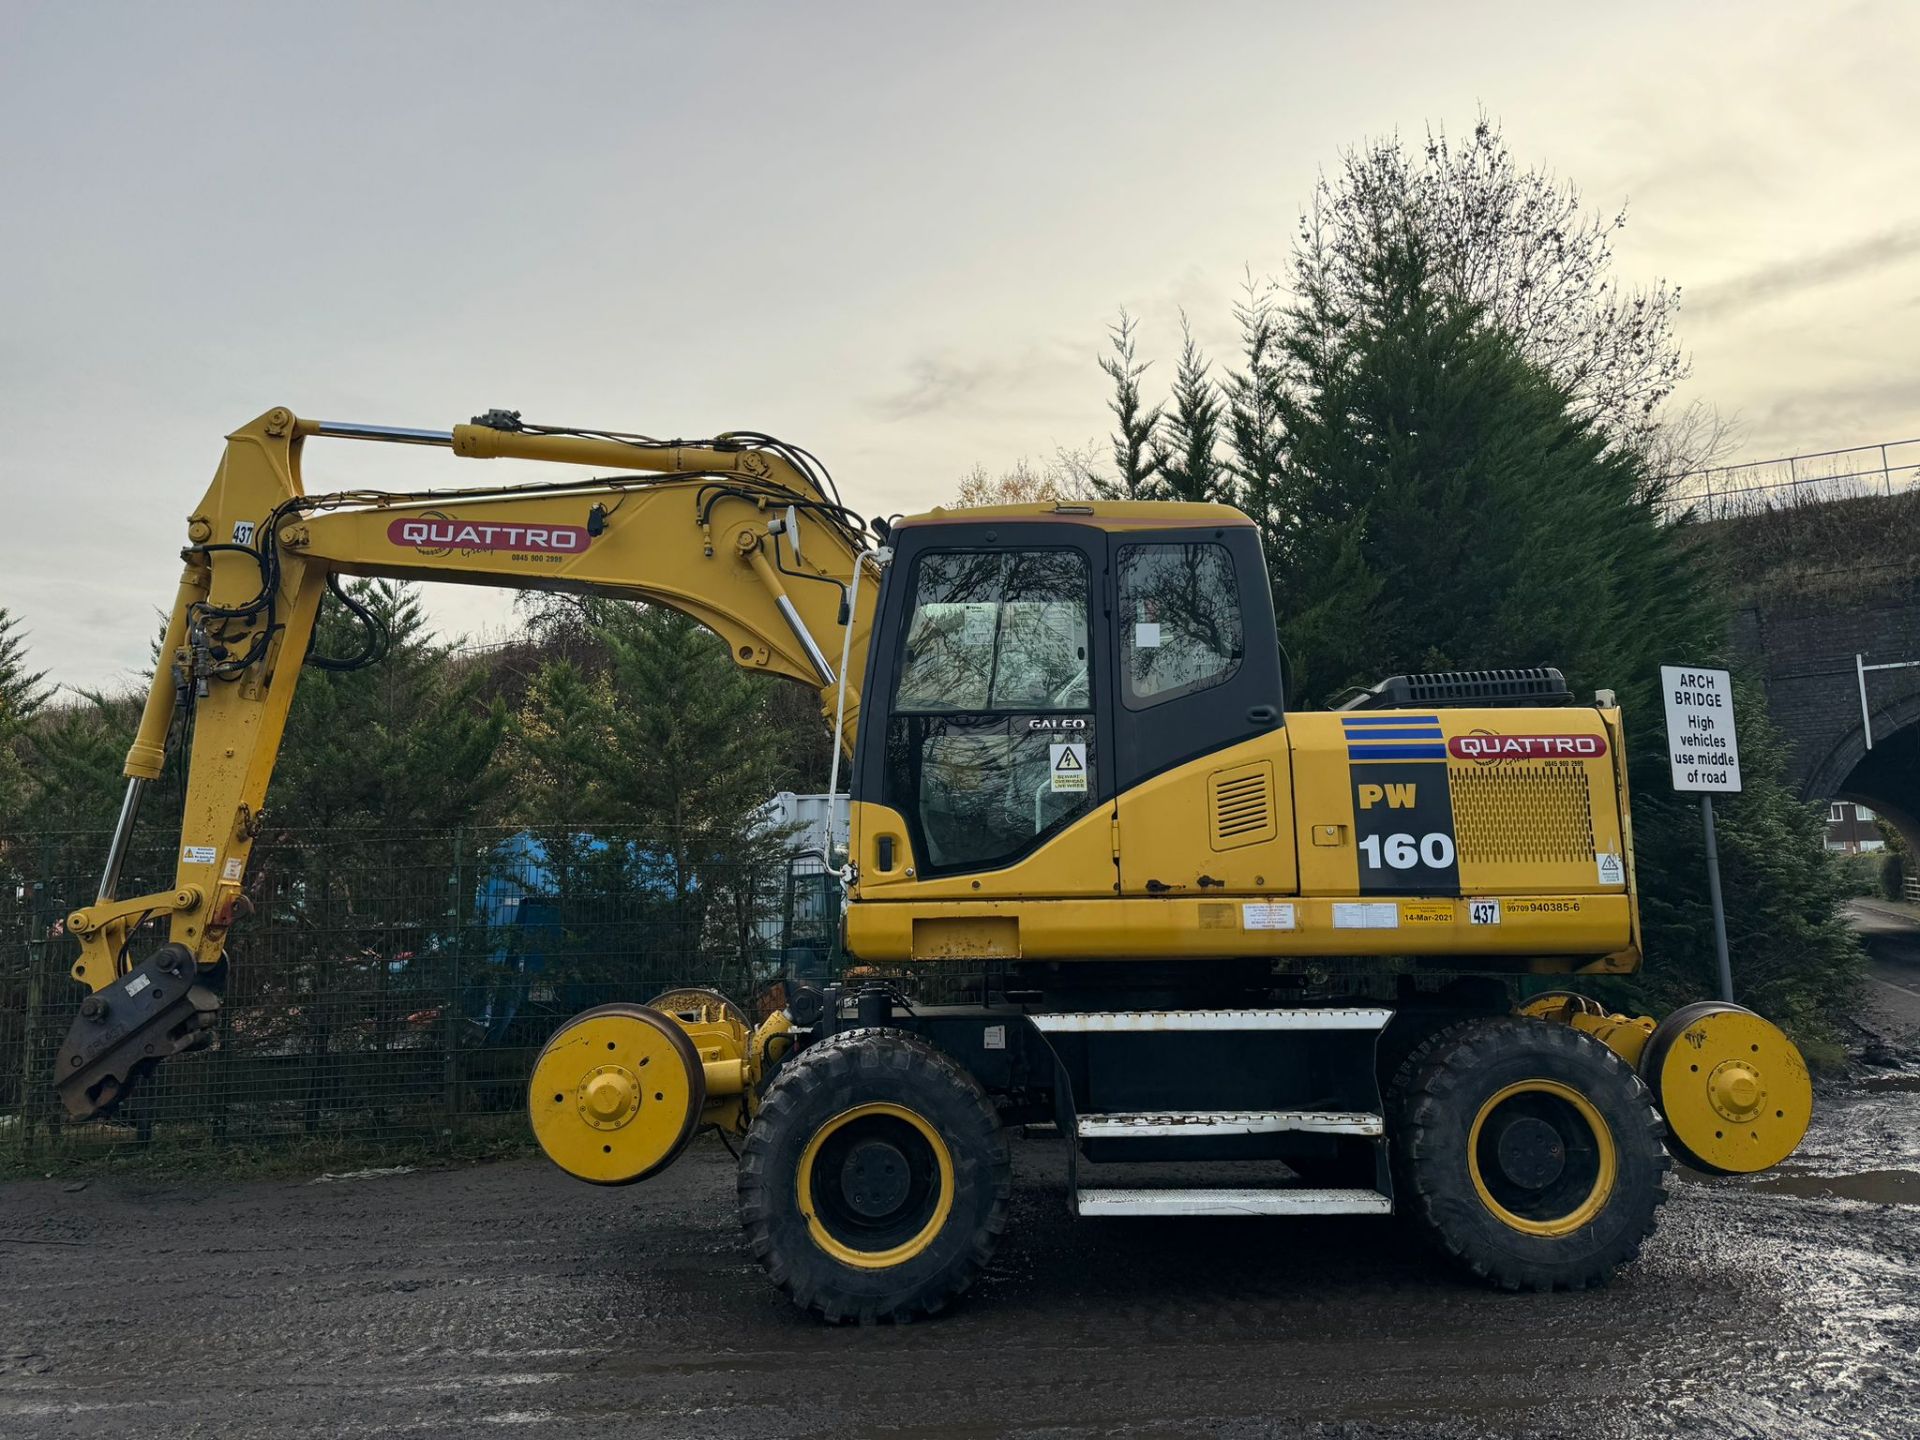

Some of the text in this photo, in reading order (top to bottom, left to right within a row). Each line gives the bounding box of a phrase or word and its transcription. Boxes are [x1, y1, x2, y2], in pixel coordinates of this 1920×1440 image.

[232, 525, 253, 544] 437
[402, 523, 577, 549] QUATTRO
[511, 553, 529, 562] 0845
[1680, 673, 1714, 689] ARCH
[1675, 691, 1722, 707] BRIDGE
[1029, 719, 1086, 730] GALEO
[1688, 714, 1714, 731] High
[1460, 738, 1596, 757] QUATTRO
[1680, 733, 1726, 747] vehicles
[1675, 752, 1735, 766] use middle
[1687, 769, 1727, 784] of road
[1358, 783, 1416, 809] PW
[1359, 832, 1455, 869] 160
[1473, 905, 1495, 924] 437
[1530, 902, 1581, 912] 940385-6
